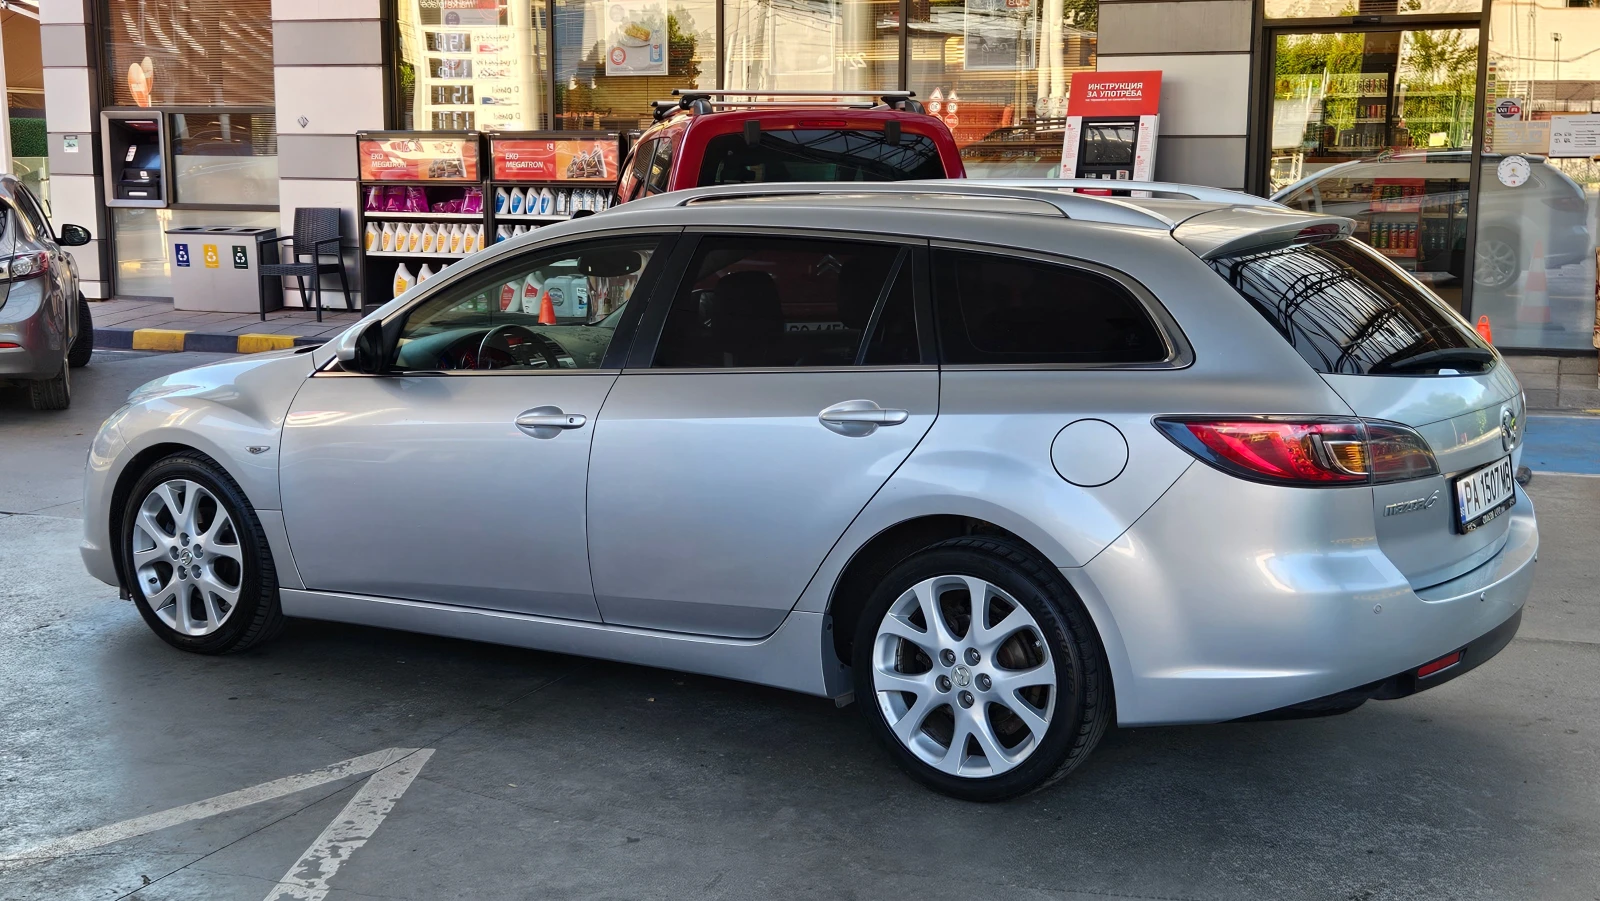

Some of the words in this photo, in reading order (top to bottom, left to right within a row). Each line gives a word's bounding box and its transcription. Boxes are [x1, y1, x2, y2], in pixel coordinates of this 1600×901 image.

[1088, 82, 1143, 91] ИНСТРУКЦИЯ
[1099, 89, 1142, 98] УПОТРЕБА
[505, 152, 518, 160] EKO
[1464, 478, 1481, 515] PA
[1480, 466, 1499, 507] 1507
